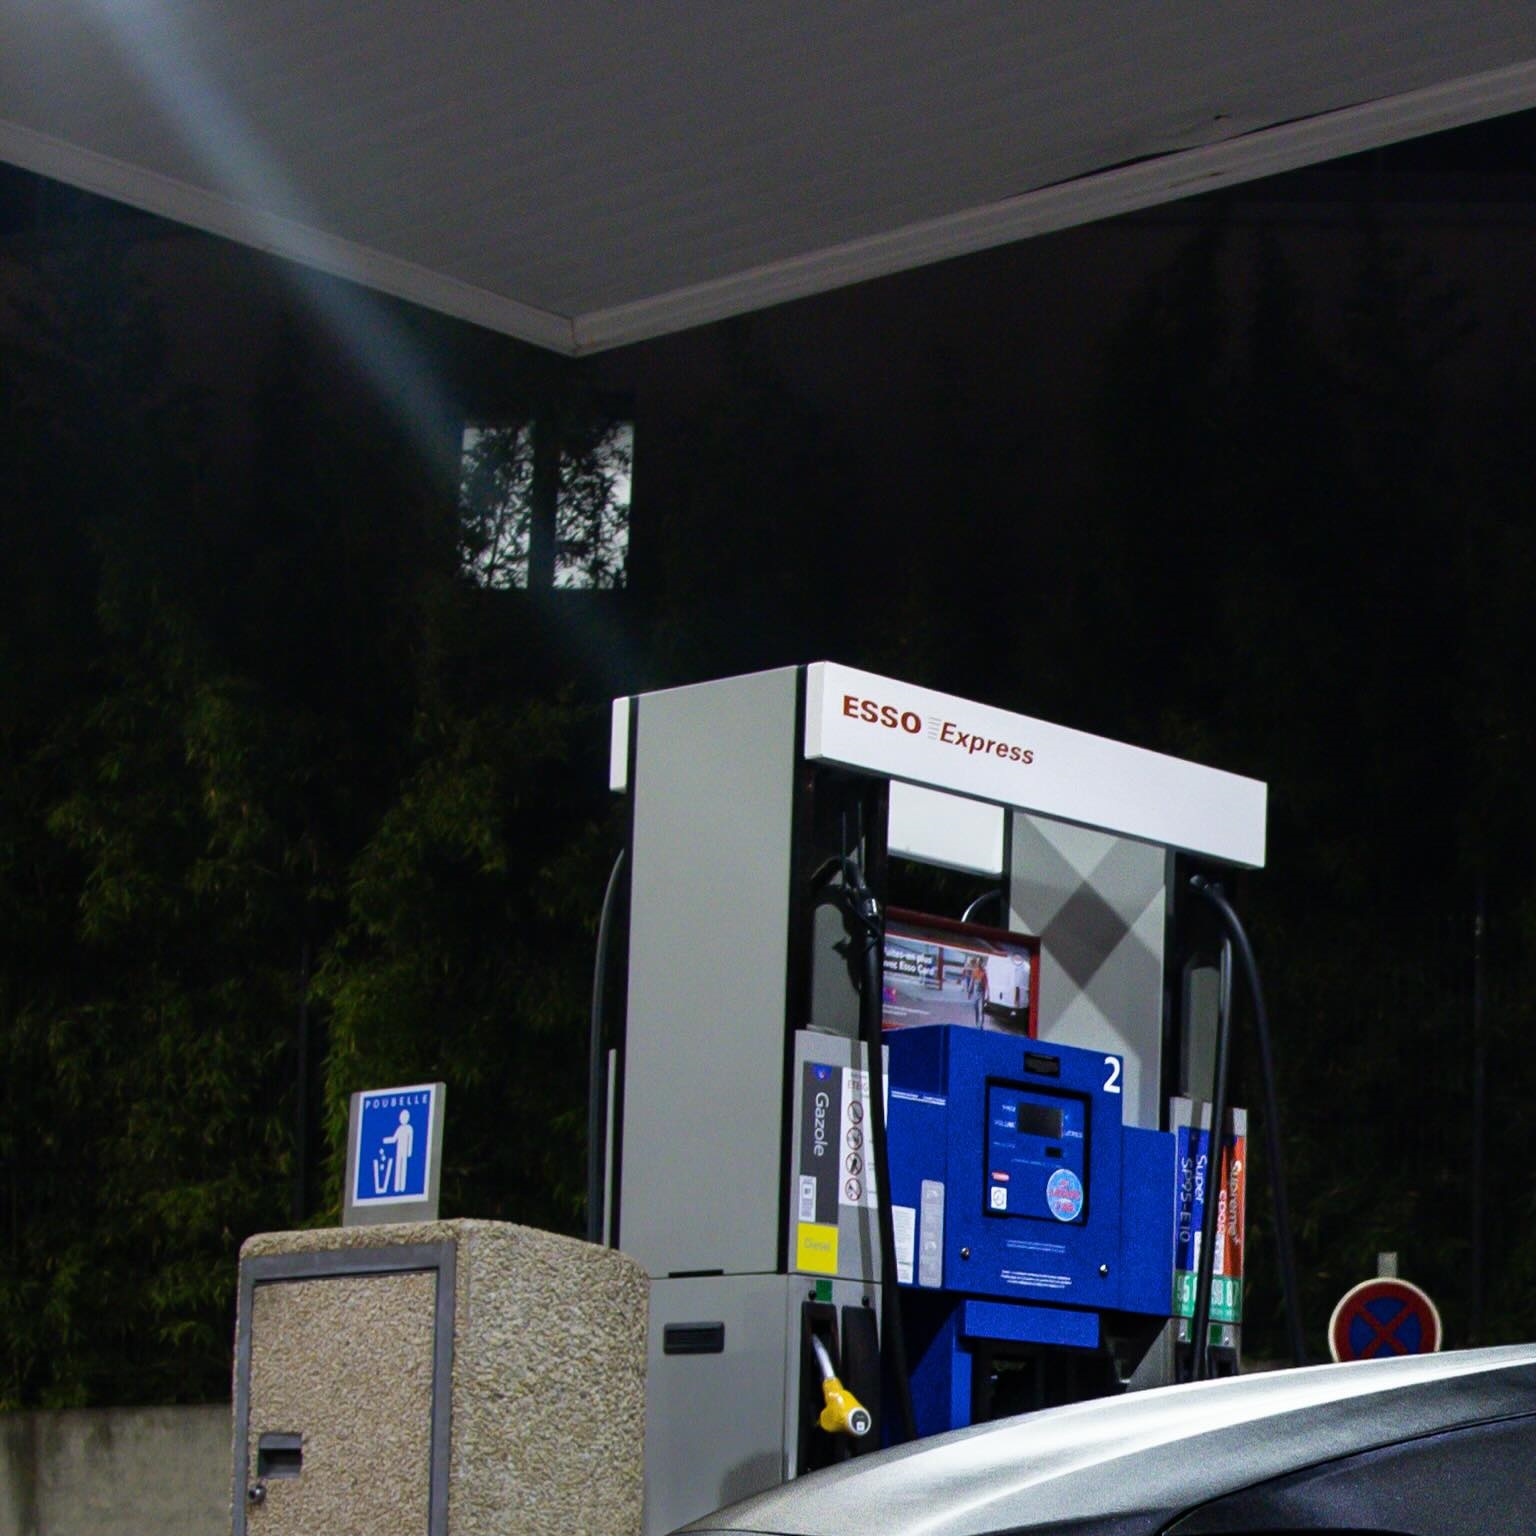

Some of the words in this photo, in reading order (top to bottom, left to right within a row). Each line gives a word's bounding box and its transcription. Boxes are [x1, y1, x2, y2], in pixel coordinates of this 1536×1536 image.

[842, 694, 922, 734] ESSO
[939, 721, 1035, 765] Express
[1103, 1056, 1121, 1094] 2
[365, 1094, 429, 1110] POUBELLE
[813, 1091, 830, 1157] Gazole
[1194, 1154, 1208, 1204] Super
